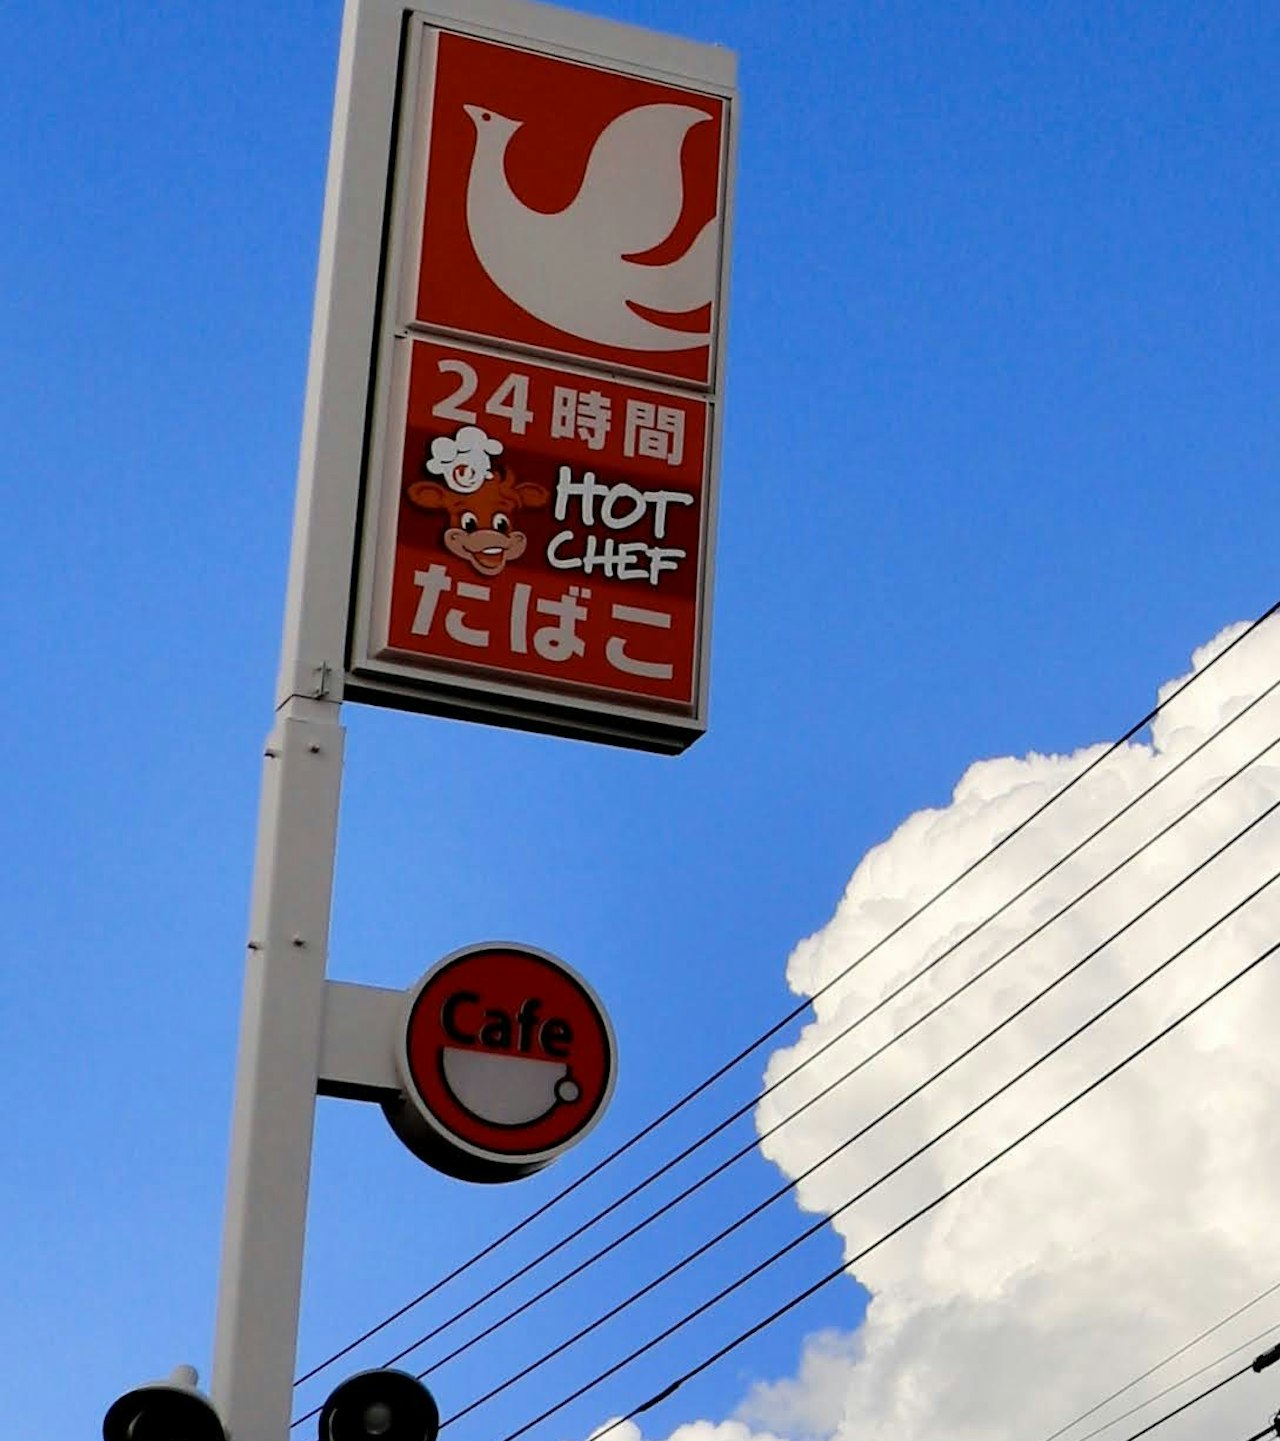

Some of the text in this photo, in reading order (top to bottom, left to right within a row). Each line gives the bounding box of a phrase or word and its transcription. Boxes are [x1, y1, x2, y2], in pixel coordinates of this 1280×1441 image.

[432, 359, 686, 466] 24時間
[554, 465, 694, 539] HOT
[547, 530, 687, 586] CHEF
[411, 563, 674, 680] たばこ
[441, 990, 574, 1058] Cafe
